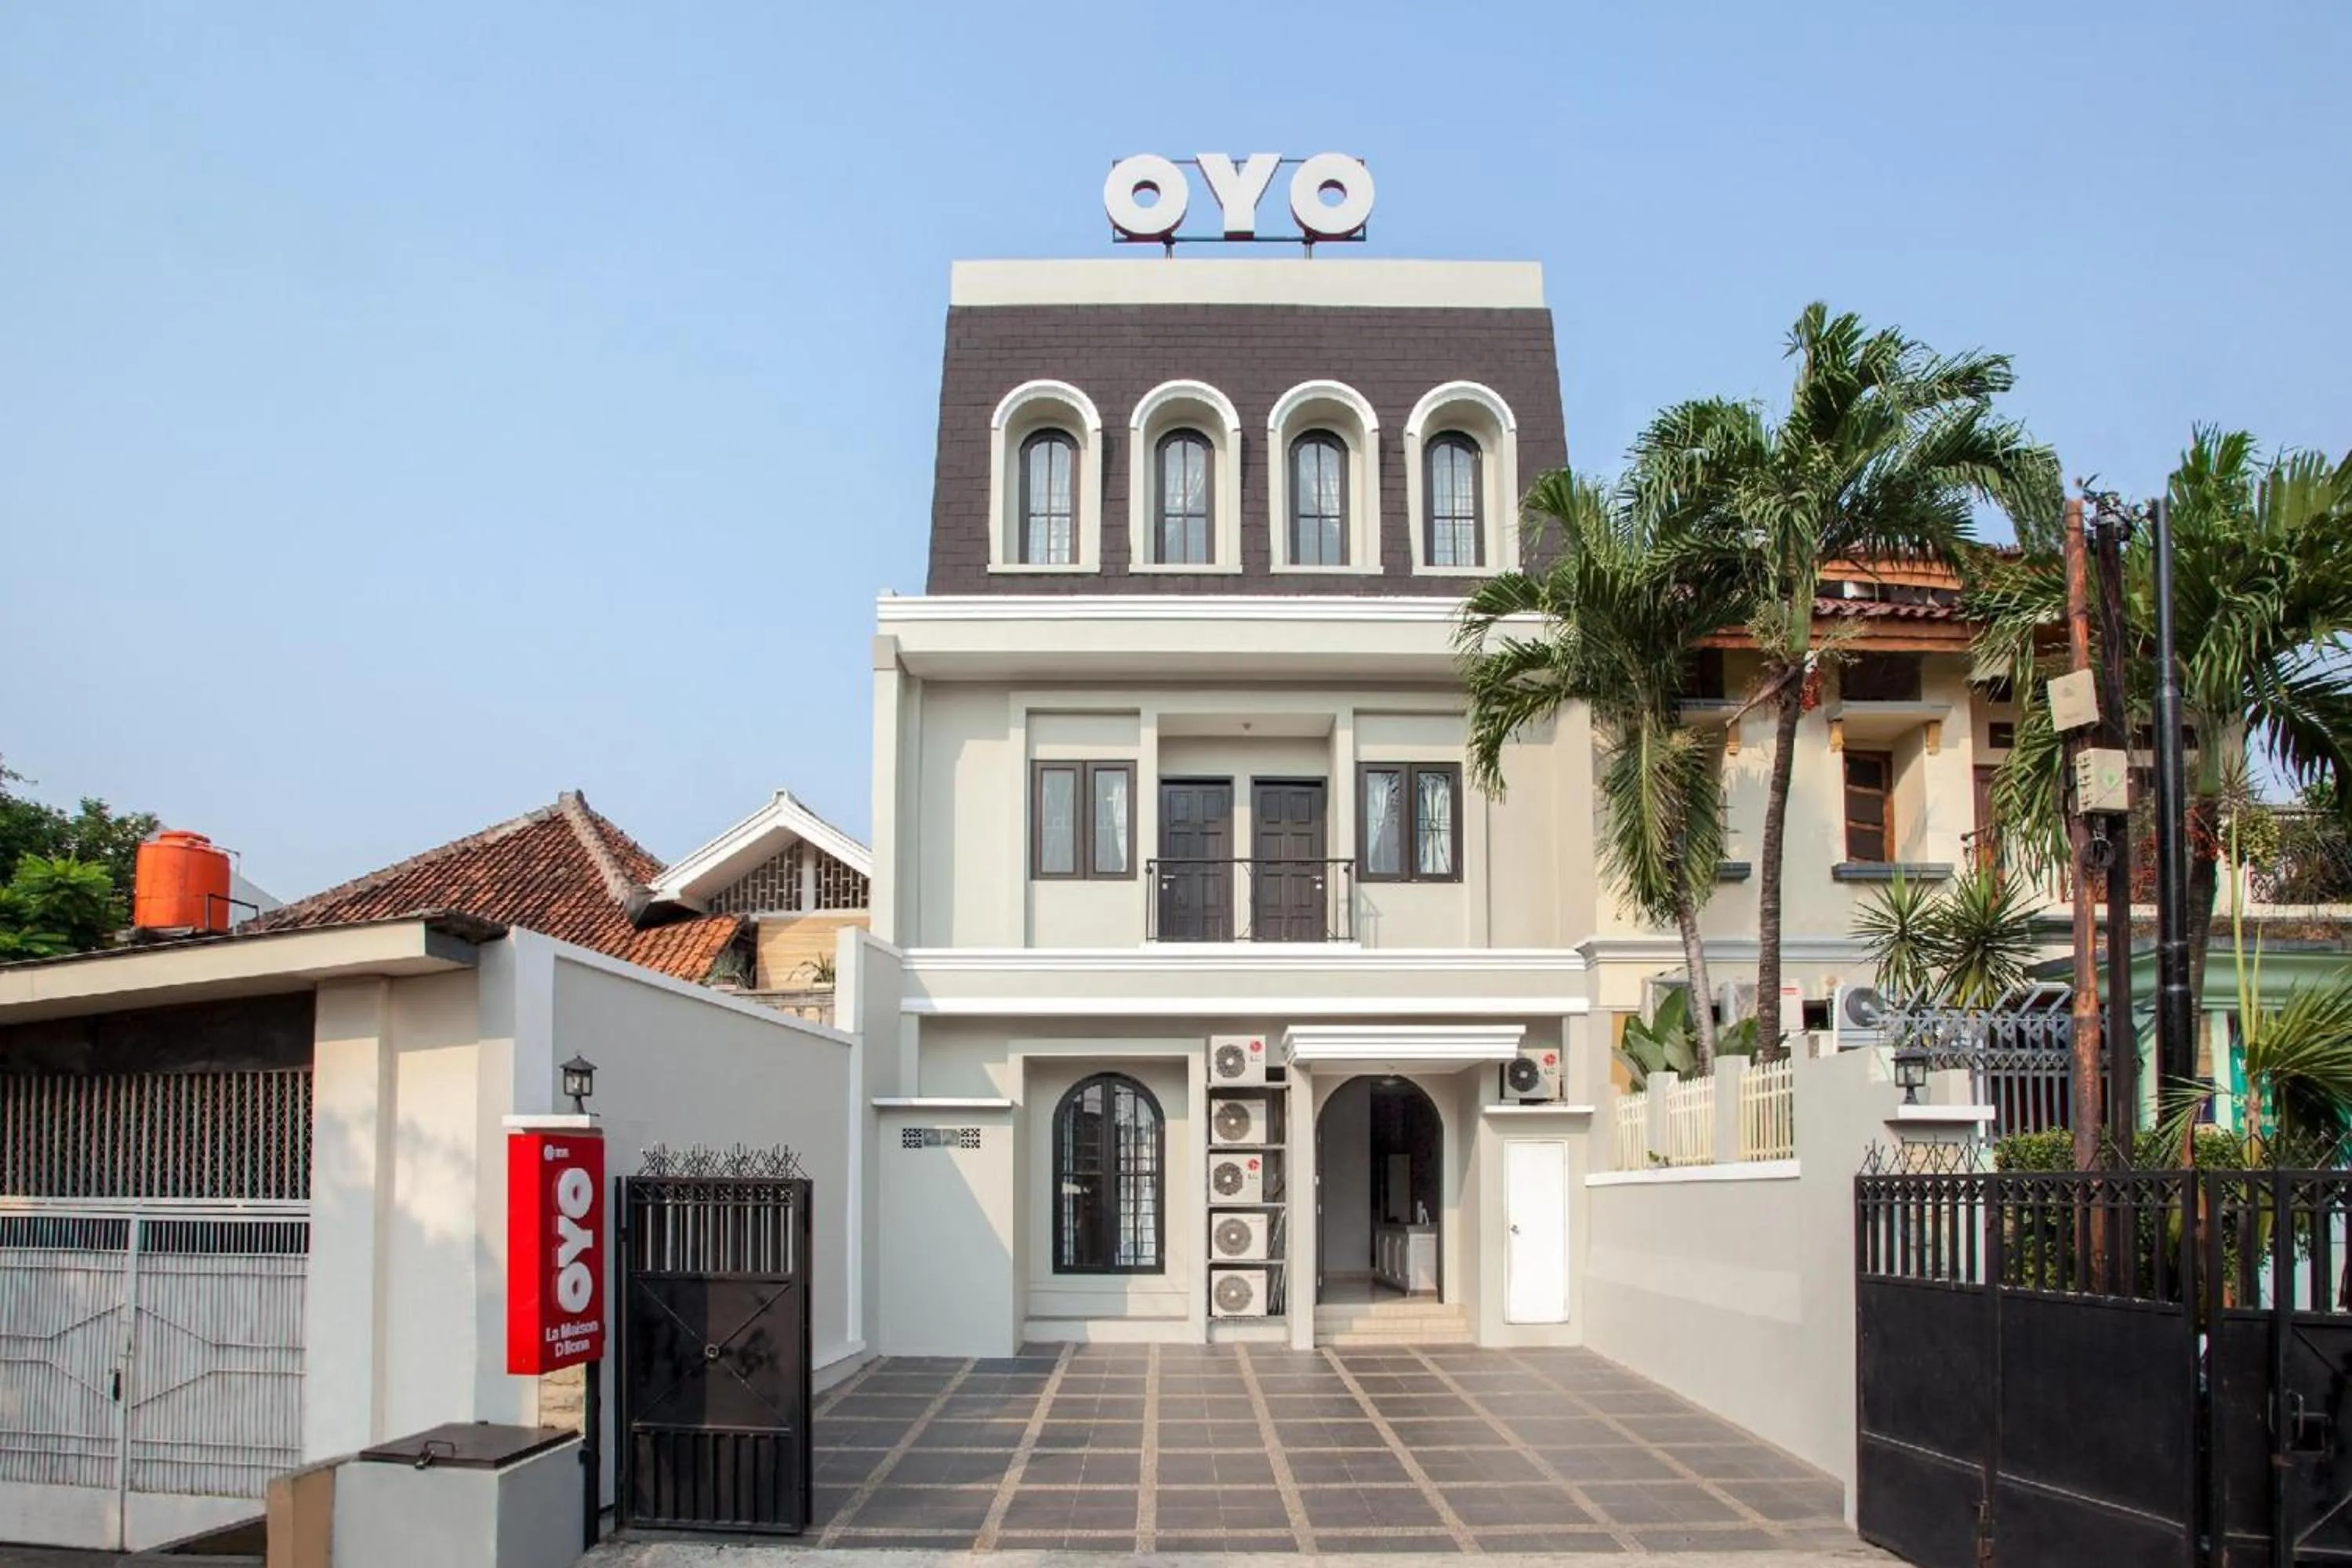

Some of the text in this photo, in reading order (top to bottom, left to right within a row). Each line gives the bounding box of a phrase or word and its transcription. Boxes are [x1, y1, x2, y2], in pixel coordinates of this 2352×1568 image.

[1104, 152, 1374, 238] OYO
[557, 1167, 593, 1314] OYO
[546, 1327, 559, 1342] La
